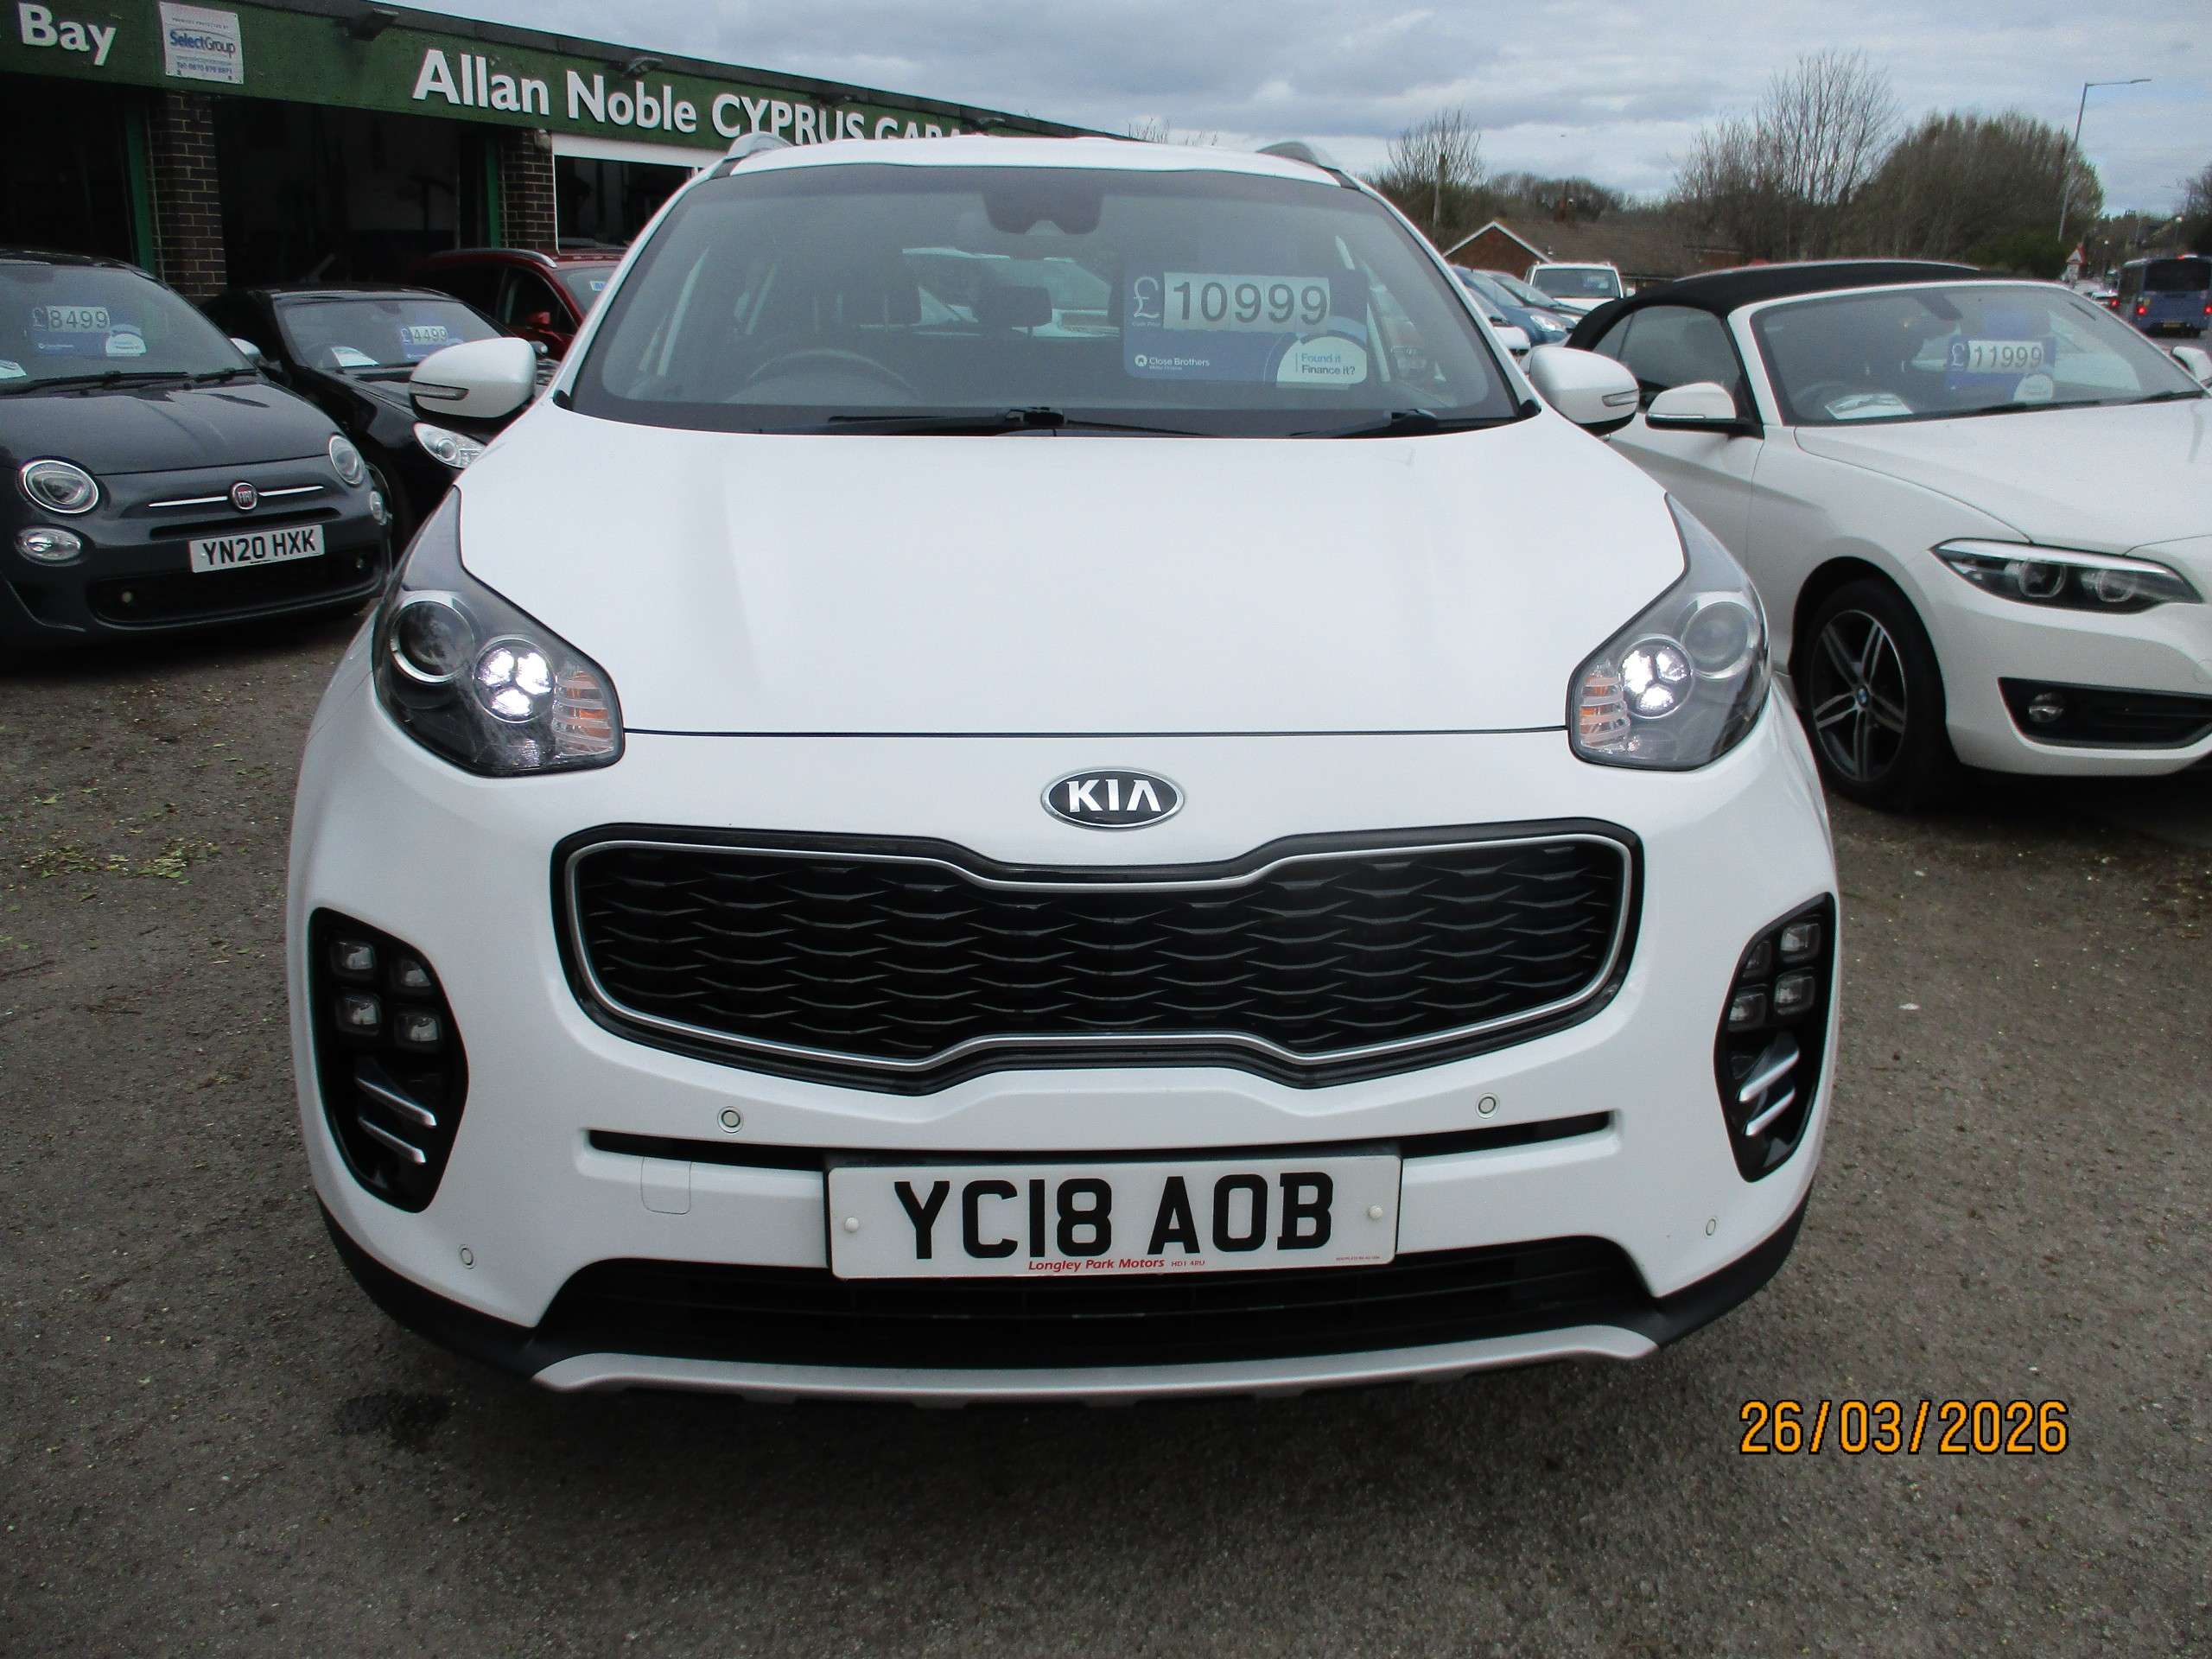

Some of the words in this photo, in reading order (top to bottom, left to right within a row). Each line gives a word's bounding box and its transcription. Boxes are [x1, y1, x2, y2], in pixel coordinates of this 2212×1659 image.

[18, 3, 117, 66] Bay
[169, 29, 236, 58] SelectGroup
[412, 48, 550, 116] Allan
[566, 70, 697, 133] Noble
[710, 92, 865, 146] CYPRUS
[1149, 357, 1173, 366] Close
[1174, 358, 1210, 367] Brothers
[1301, 352, 1333, 363] Found
[1301, 364, 1341, 375] Finance
[202, 536, 266, 565] YN20
[272, 529, 316, 557] HXK
[1066, 779, 1162, 813] KIA
[893, 1178, 1113, 1260] YC18
[1028, 1260, 1082, 1272] Longley
[1085, 1259, 1114, 1269] Park
[1118, 1258, 1165, 1268] Motors
